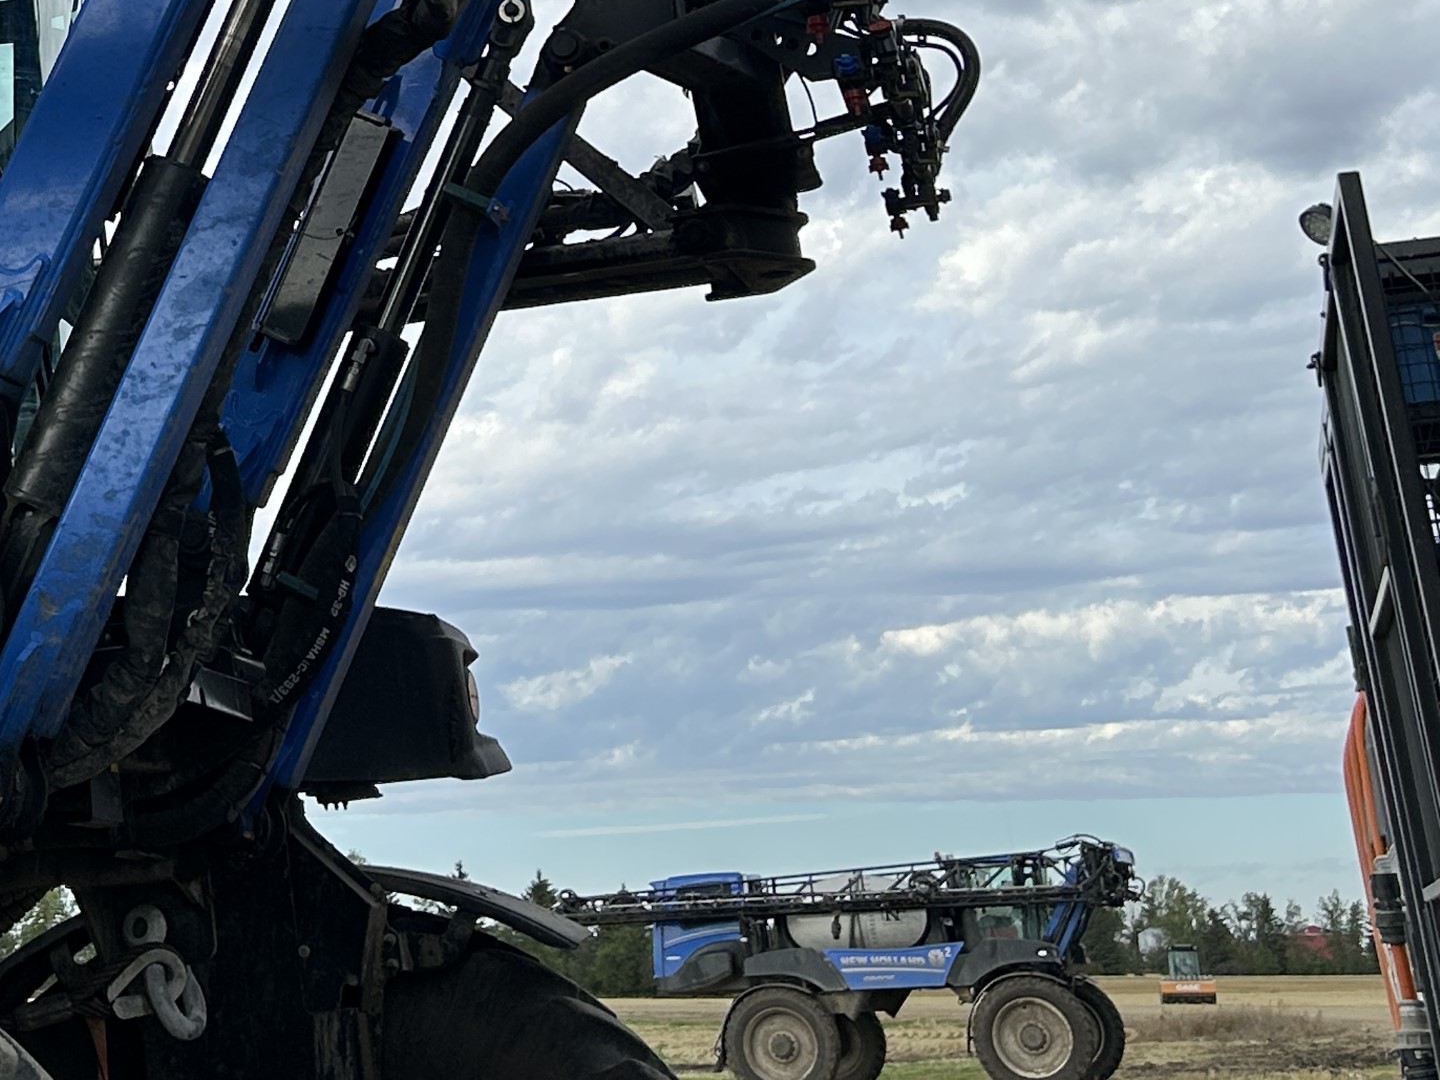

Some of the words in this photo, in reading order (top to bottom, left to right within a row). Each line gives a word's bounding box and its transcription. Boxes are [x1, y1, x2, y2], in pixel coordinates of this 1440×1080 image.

[305, 626, 331, 661] MSHA
[840, 955, 867, 966] NEW
[870, 955, 926, 966] HOLLAND
